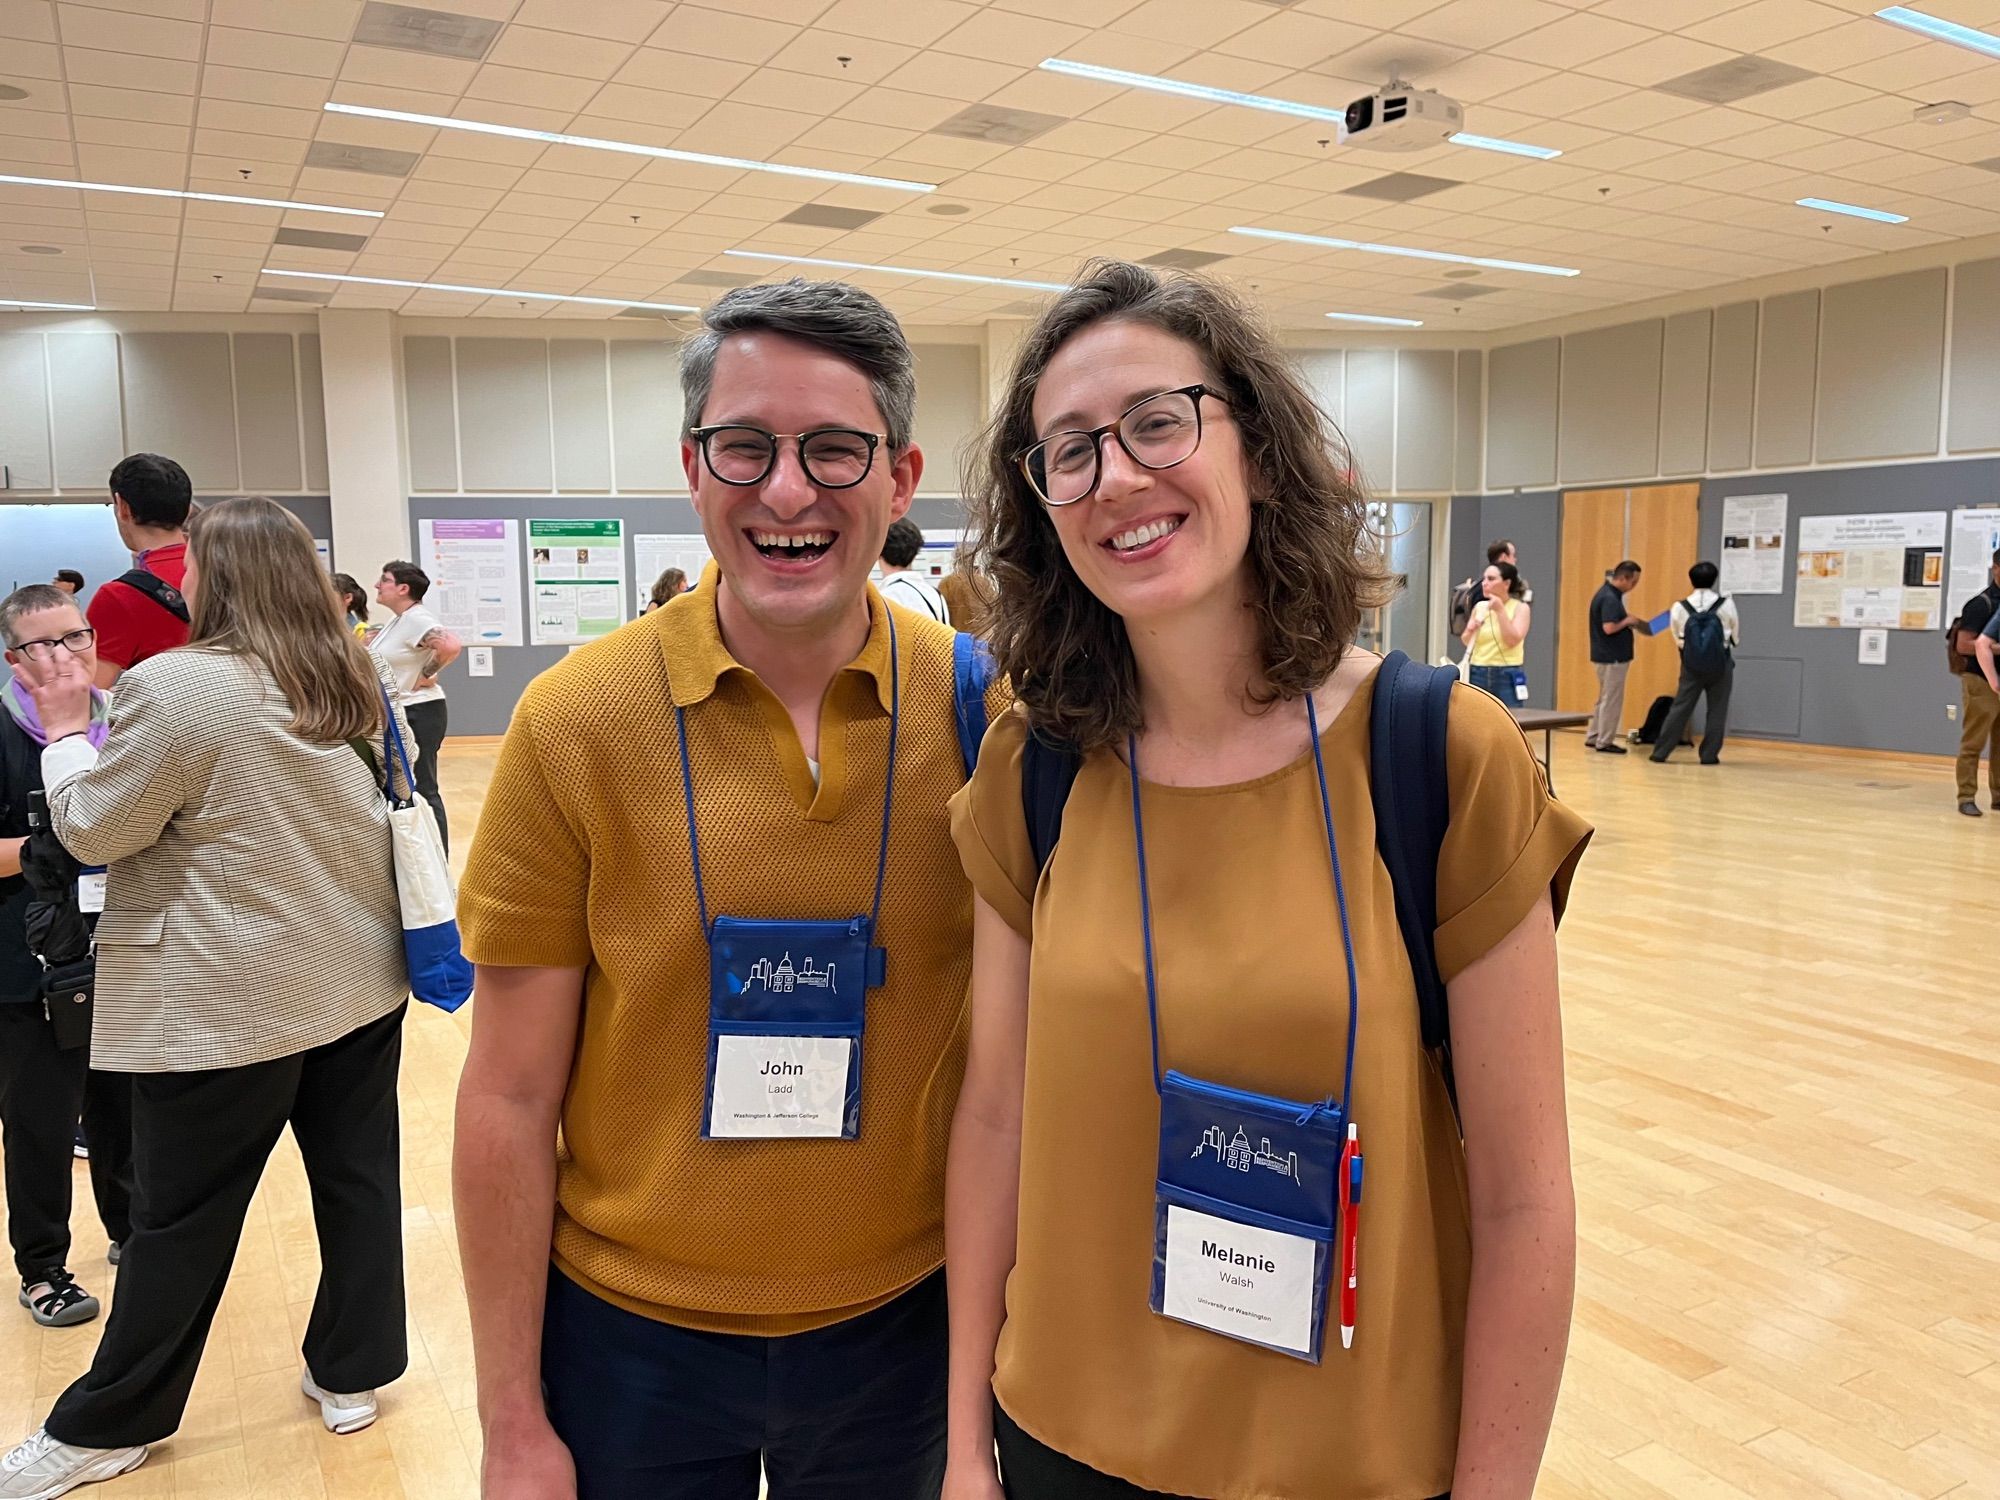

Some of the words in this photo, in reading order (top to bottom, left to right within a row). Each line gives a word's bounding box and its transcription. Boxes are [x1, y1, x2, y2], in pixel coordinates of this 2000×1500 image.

[760, 1061, 803, 1076] John
[768, 1084, 793, 1094] Ladd
[1201, 1240, 1275, 1273] Melanie
[1219, 1271, 1254, 1289] Walsh
[1197, 1297, 1227, 1311] University
[1235, 1308, 1272, 1322] Washington
